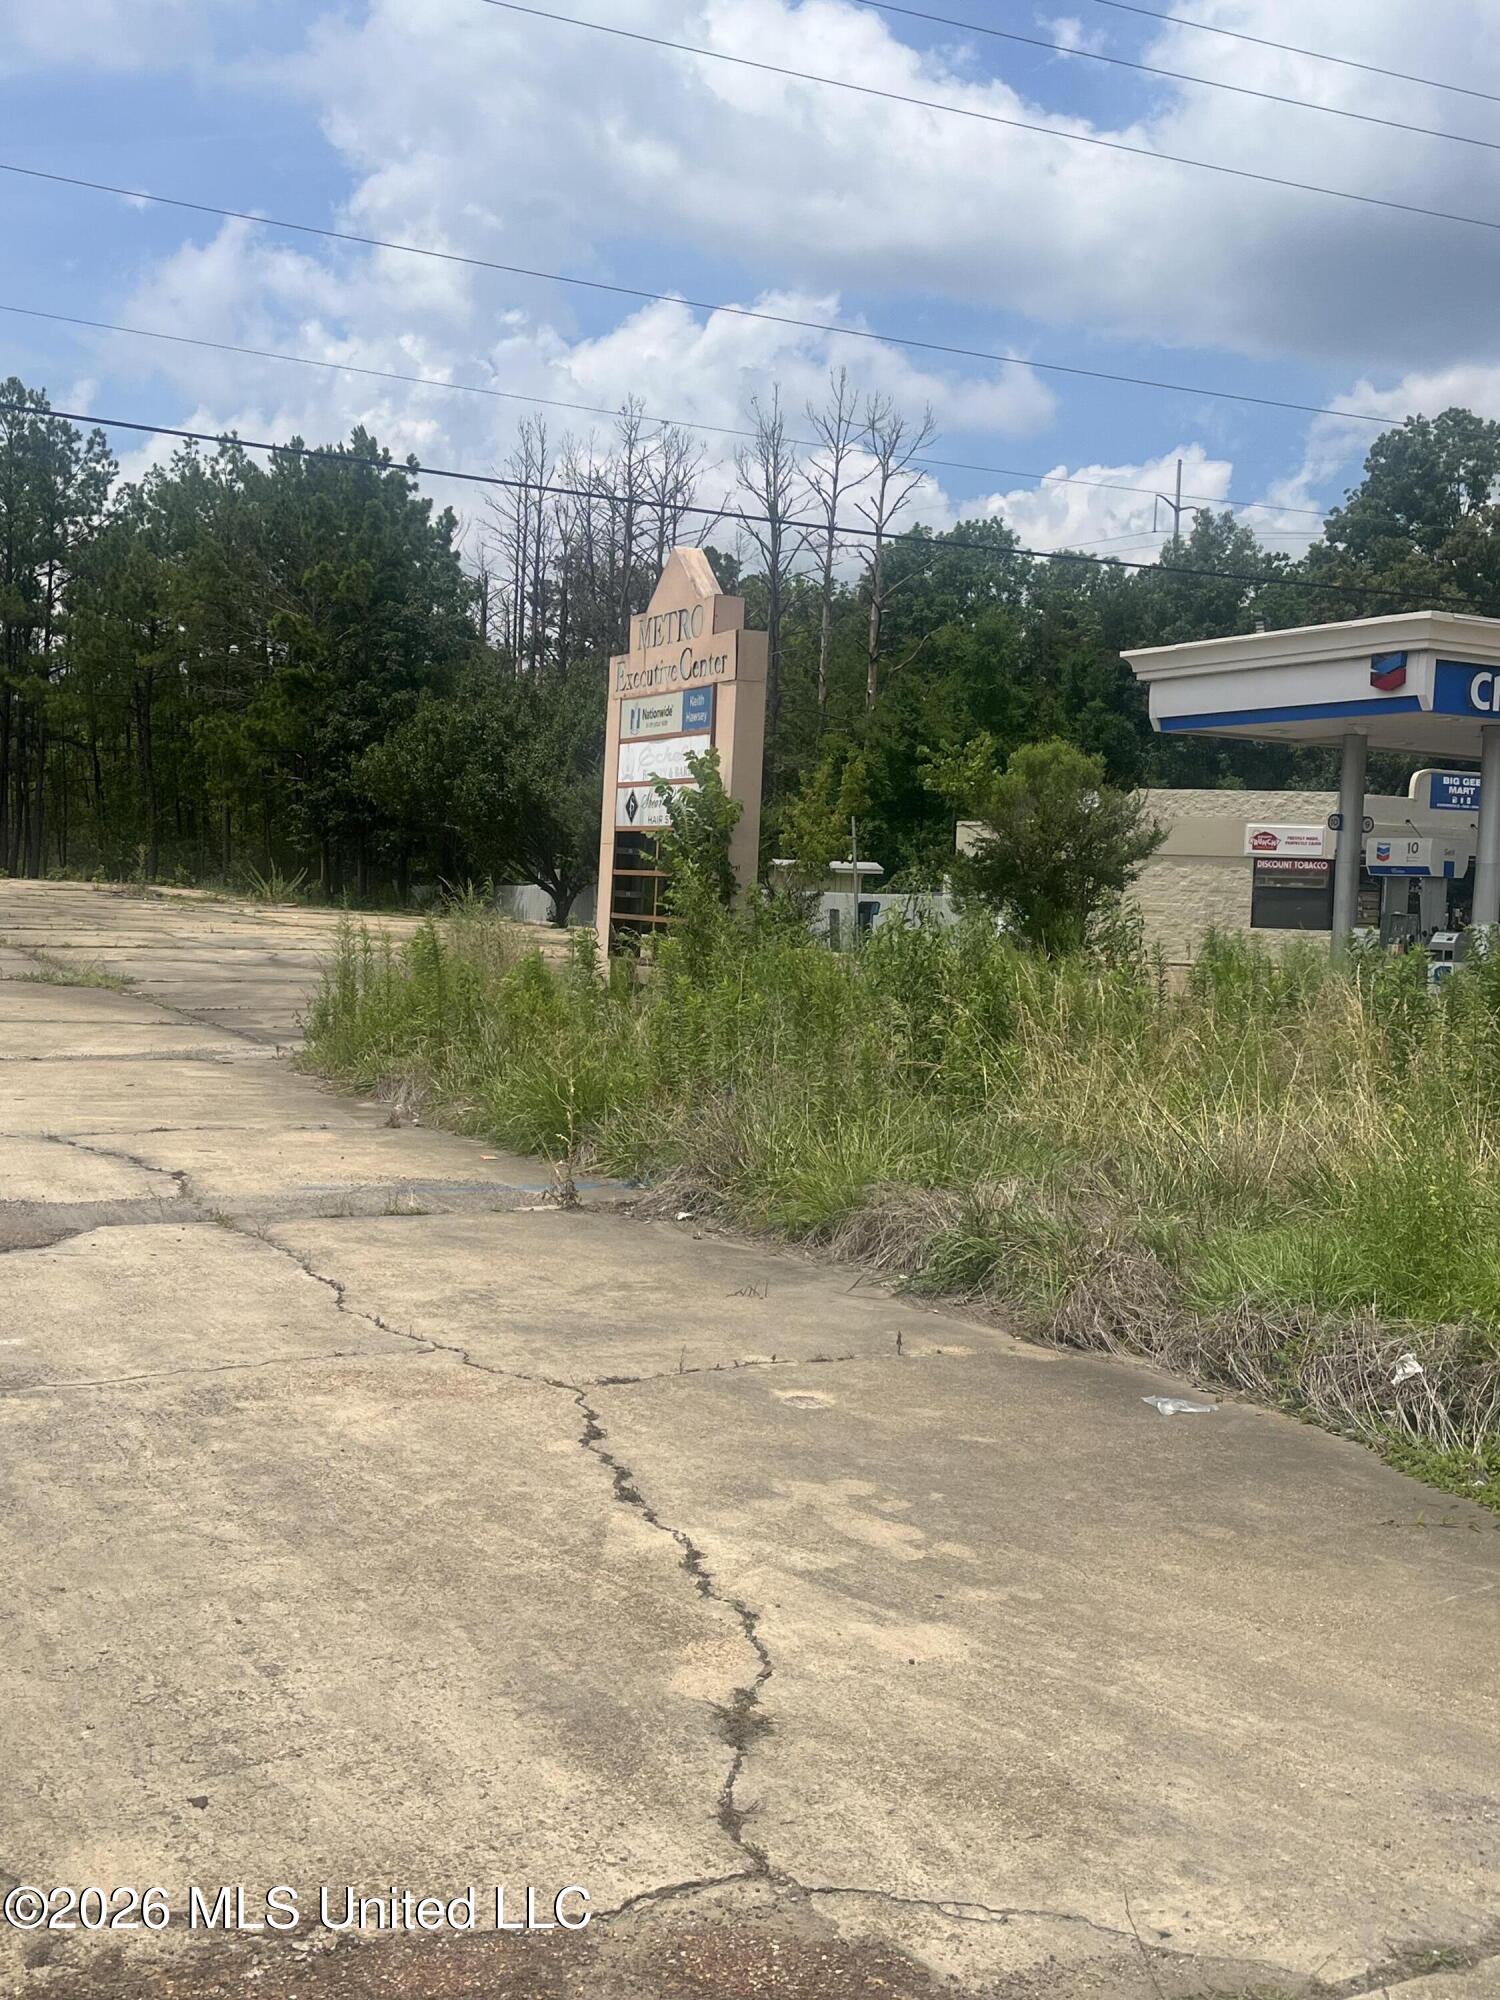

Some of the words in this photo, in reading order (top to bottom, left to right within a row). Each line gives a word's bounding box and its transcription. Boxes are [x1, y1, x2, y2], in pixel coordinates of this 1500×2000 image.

[637, 604, 704, 651] METRO
[615, 660, 678, 692] Executive
[679, 647, 728, 681] Center
[642, 703, 673, 721] Nationwide
[1442, 776, 1460, 786] BIG
[1448, 785, 1476, 795] MART
[647, 814, 663, 825] HAIR
[1407, 842, 1419, 854] 10
[1257, 860, 1292, 869] DISCOUNT
[1294, 861, 1328, 870] TOBACCO
